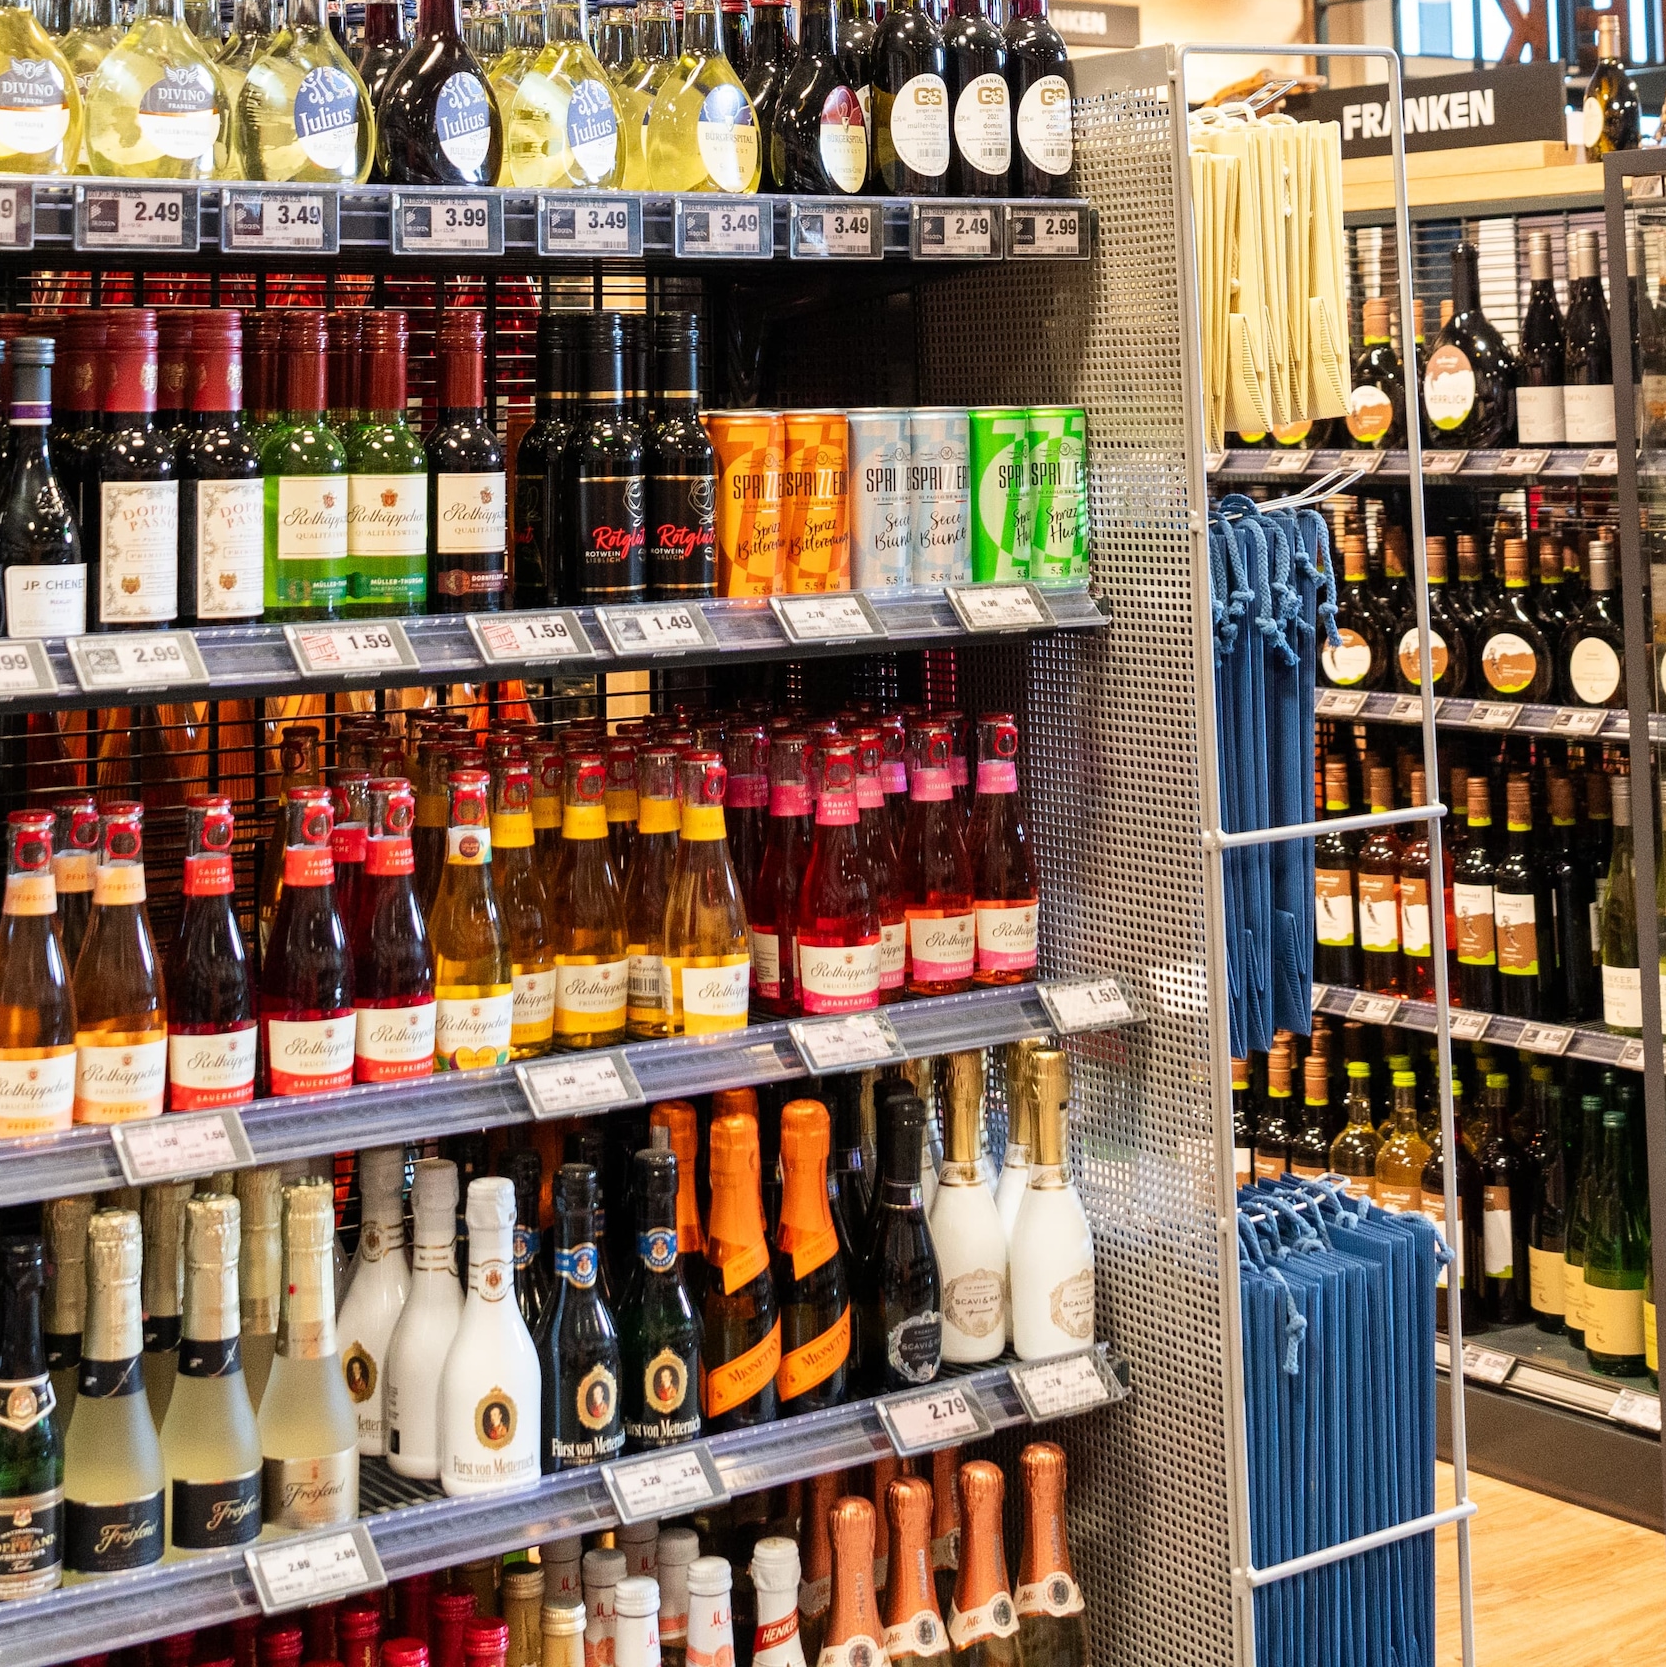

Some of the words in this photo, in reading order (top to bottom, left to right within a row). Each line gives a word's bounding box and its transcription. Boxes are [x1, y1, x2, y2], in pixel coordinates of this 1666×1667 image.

[1, 80, 55, 98] DIVINO
[157, 85, 208, 102] DIVINO
[297, 107, 352, 135] Julius
[441, 112, 486, 140] Julius
[570, 119, 613, 147] Julius
[133, 202, 181, 223] 2.49
[277, 204, 322, 225] 3.49
[444, 207, 487, 229] 3.99
[587, 210, 628, 230] 3.49
[720, 213, 759, 233] 3.49
[833, 216, 870, 234] 3.49
[955, 218, 989, 235] 2.49
[1045, 218, 1077, 236] 2.99
[1046, 506, 1079, 524] Sprizz
[804, 518, 837, 536] Sprizz
[585, 550, 622, 560] ROTWEIN
[650, 546, 685, 557] ROTWEIN
[526, 621, 568, 640] 1.59
[652, 612, 693, 632] 1.49
[346, 633, 392, 652] 1.59
[134, 644, 181, 664] 2.99
[826, 807, 851, 818] APFEL
[195, 875, 231, 886] KIRSCHE
[809, 957, 879, 985] Rotkäppchen
[820, 996, 874, 1007] GRANATAPFEL
[1086, 985, 1121, 1006] 1.59
[81, 1063, 163, 1086] Rotkäppchen
[101, 1103, 149, 1116] PFIRSICH
[928, 1396, 967, 1420] 2.79
[644, 1425, 658, 1439] von
[660, 1417, 701, 1438] Metternich
